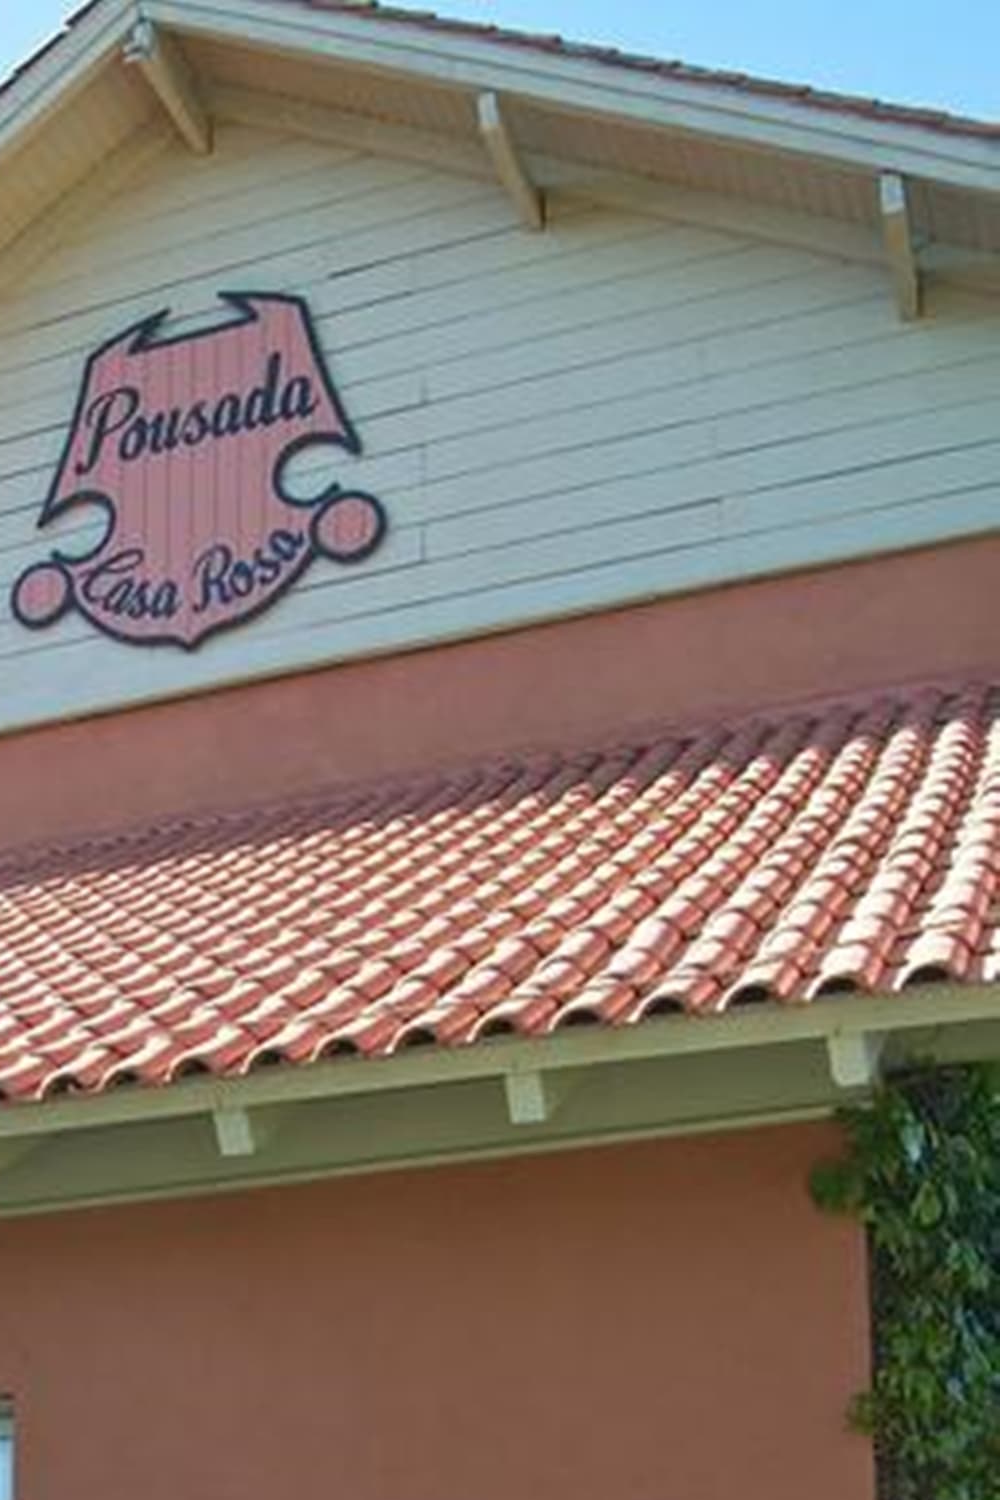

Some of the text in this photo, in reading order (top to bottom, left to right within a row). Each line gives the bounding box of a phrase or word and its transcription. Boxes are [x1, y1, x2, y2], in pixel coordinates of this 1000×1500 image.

[75, 352, 319, 475] Pousada
[80, 530, 304, 619] Casa Rosa
